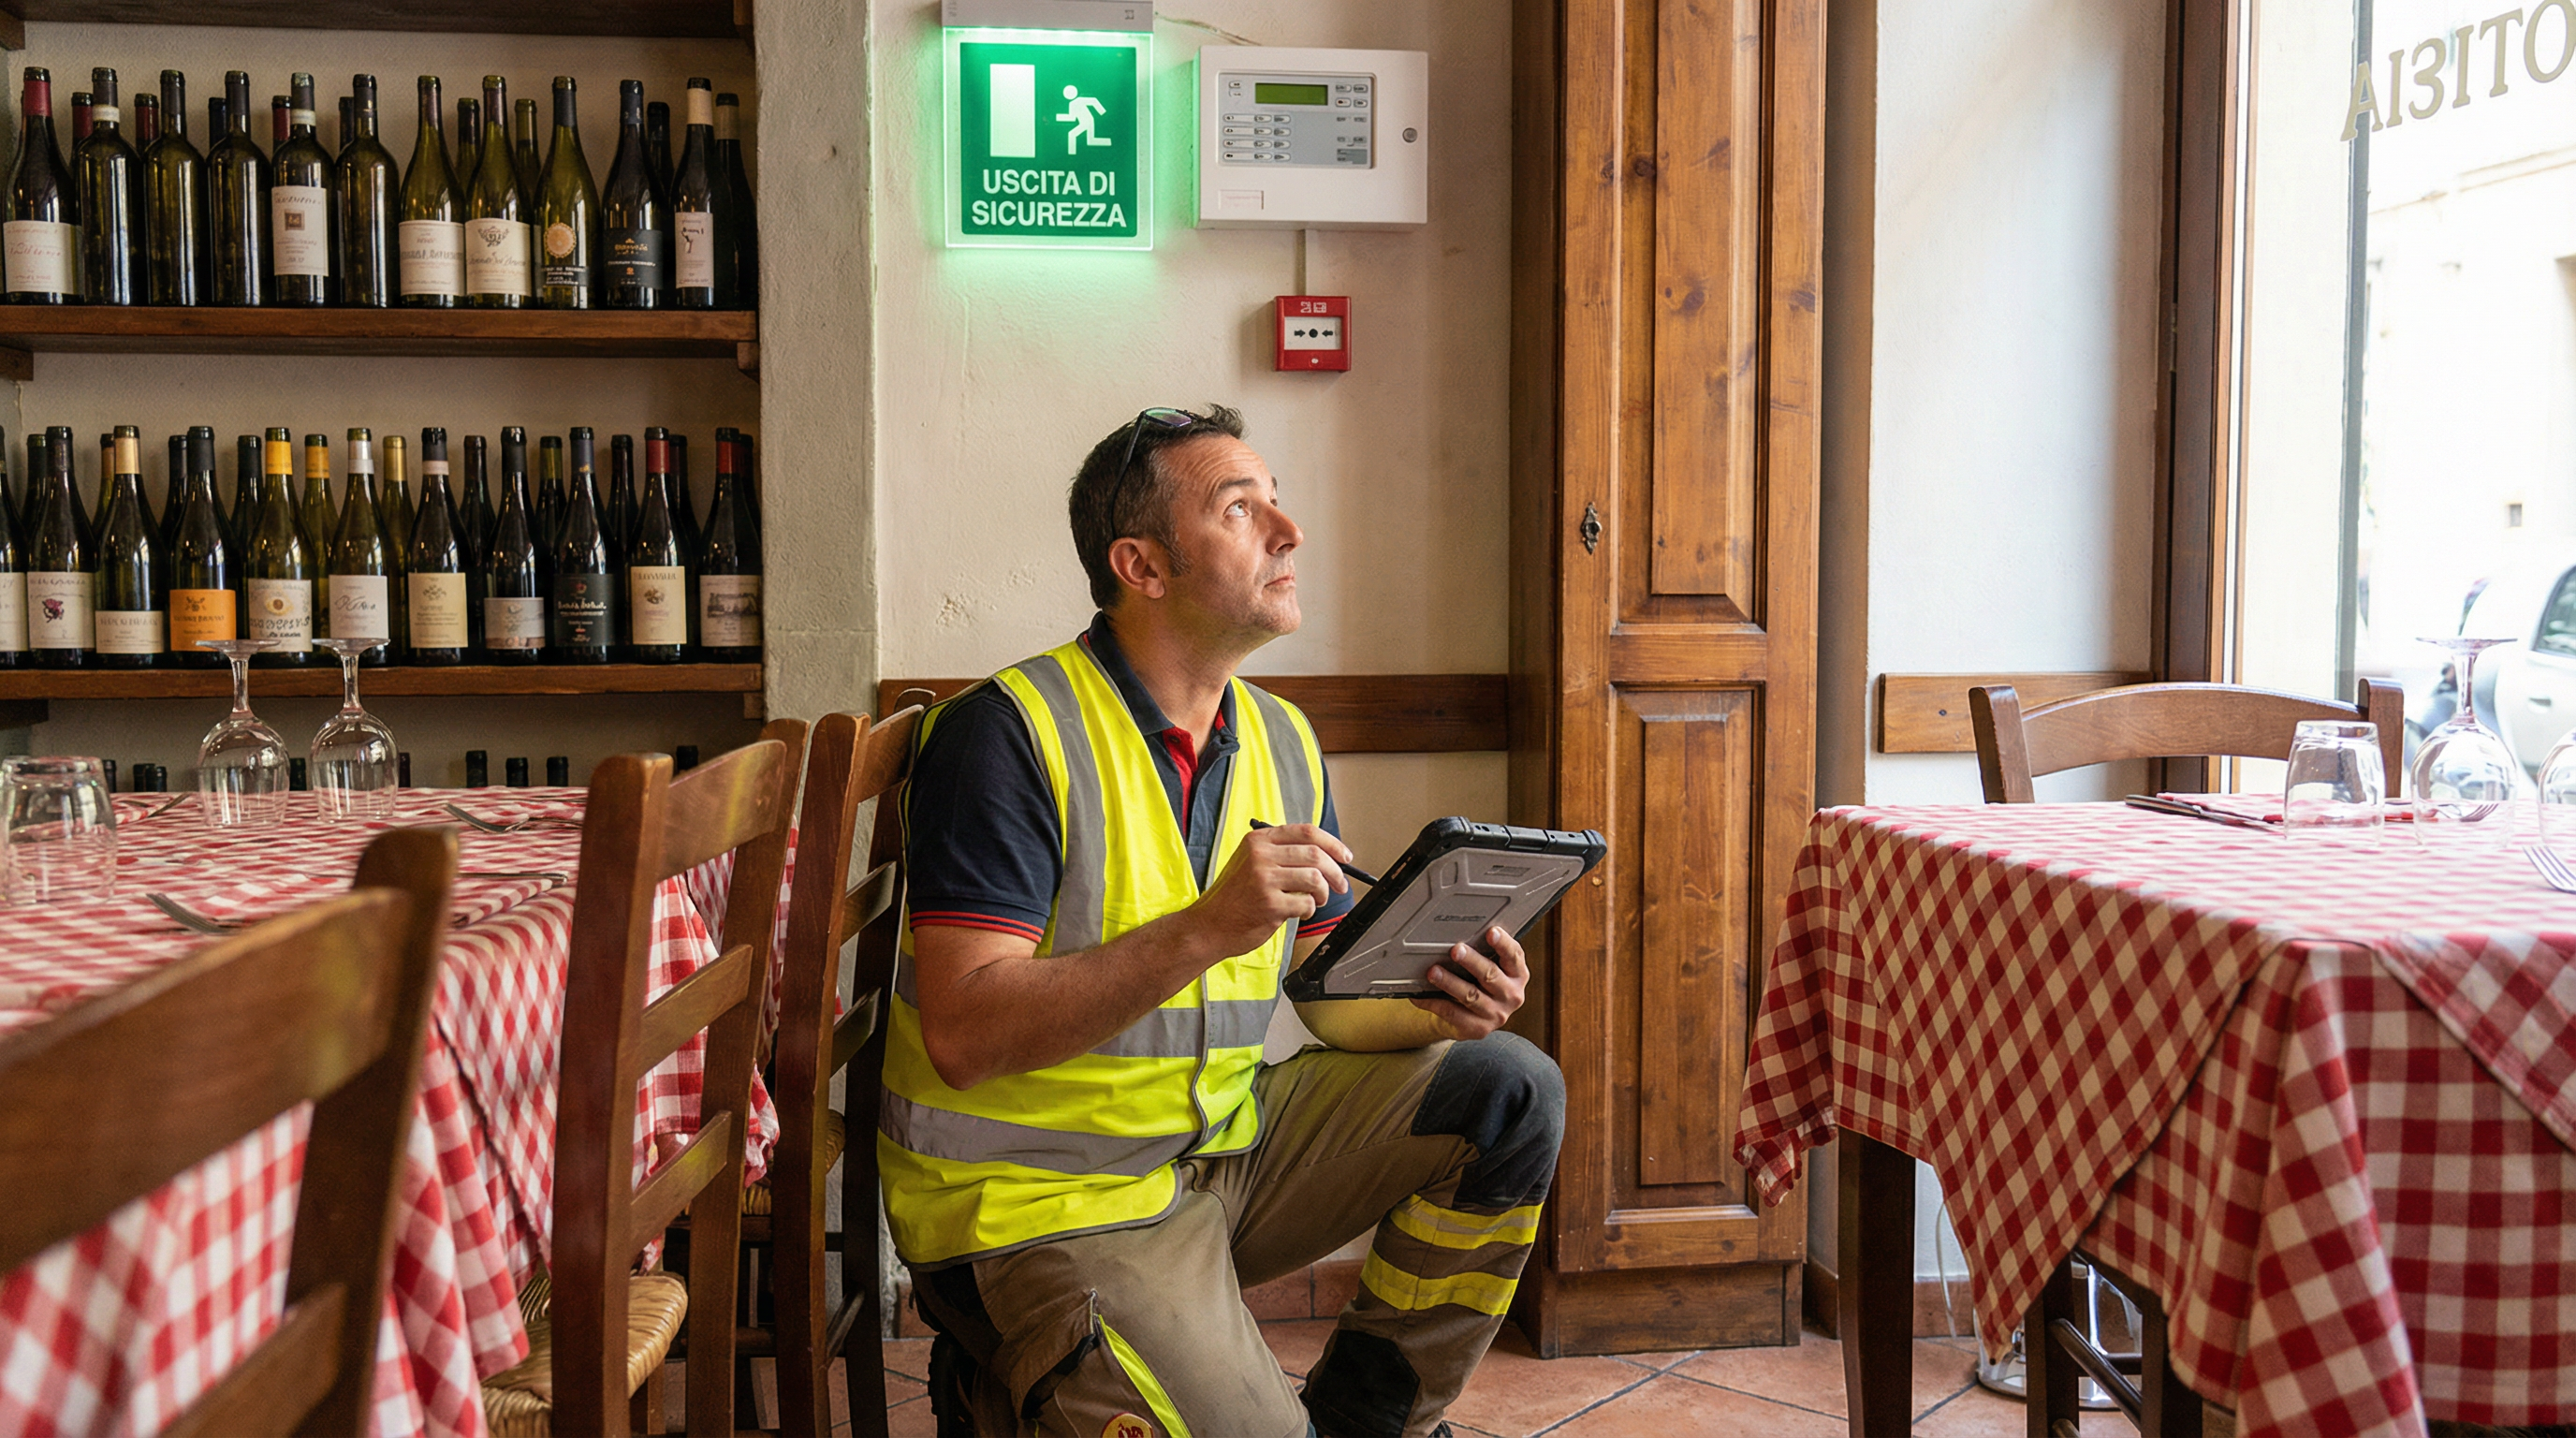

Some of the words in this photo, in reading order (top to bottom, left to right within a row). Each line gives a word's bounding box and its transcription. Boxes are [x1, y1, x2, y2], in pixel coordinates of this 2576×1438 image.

[983, 169, 1082, 195] USCITA
[1089, 171, 1115, 196] DI
[972, 200, 1127, 227] SICUREZZA
